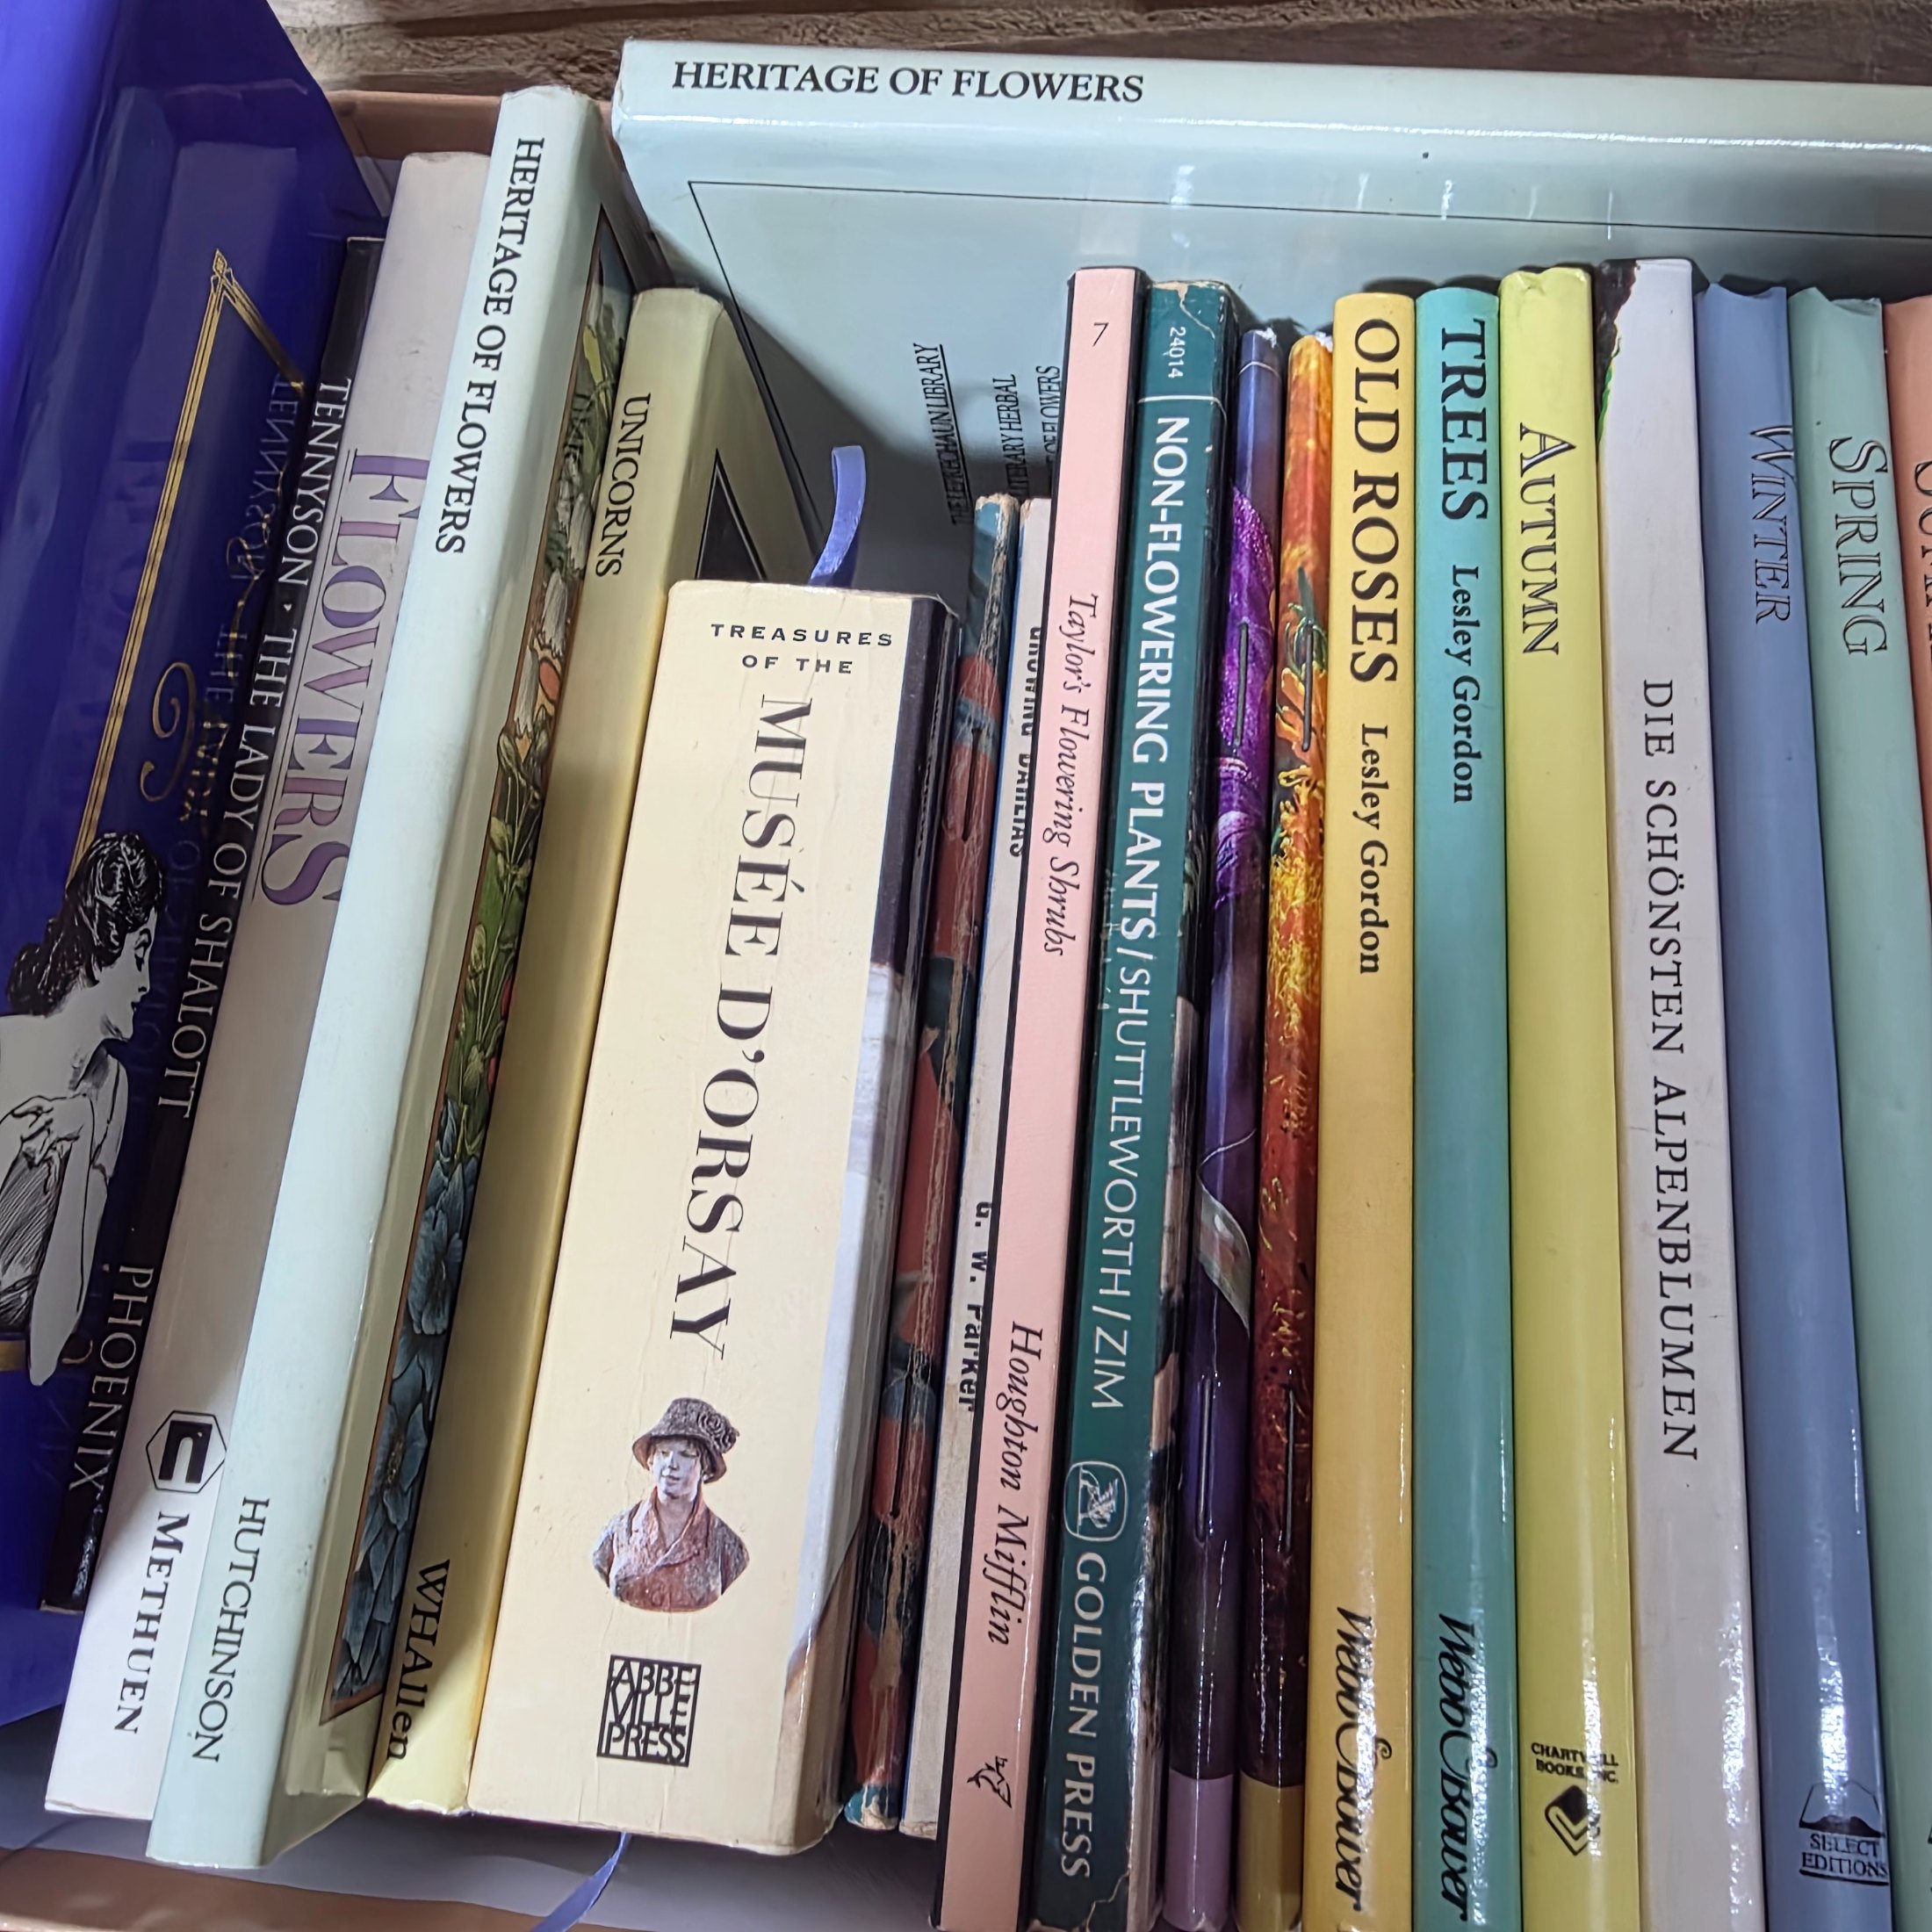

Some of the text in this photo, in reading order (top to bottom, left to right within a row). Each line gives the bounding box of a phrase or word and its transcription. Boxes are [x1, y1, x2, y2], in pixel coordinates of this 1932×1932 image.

[672, 61, 1143, 103] HERITAGE OF FLOWERS
[436, 138, 544, 553] HERITAGE OF FLOWERS
[913, 342, 950, 409] LIBRARY
[992, 373, 1023, 432] HERBAL
[1092, 322, 1109, 347] 7
[1168, 326, 1186, 378] 24014
[279, 378, 352, 587] TENNYSON
[595, 393, 652, 578] UNICORNS
[1440, 319, 1489, 804] TREES Lesley Gordon
[1518, 422, 1576, 657] AUTUMN
[1749, 425, 1797, 624] WINTER
[1829, 436, 1888, 655] SPRING
[249, 629, 298, 708] THE
[262, 449, 429, 905] FLOWERS
[710, 624, 892, 647] TREASURES
[741, 654, 853, 674] OF THE
[1133, 417, 1190, 762] NON-FLOWERING
[1350, 318, 1401, 975] OLD ROSES Lesley Gordon
[206, 840, 248, 903] OF
[223, 722, 277, 833] LADY
[1042, 594, 1099, 956] Taylor's Flowering Shrubs
[157, 912, 235, 1119] SHALOTT
[669, 694, 813, 1360] MUSÉE D'ORSAY
[1643, 680, 1698, 1460] DIE SCHÖNSTEN ALPENBLUMEN
[68, 1265, 155, 1491] PHOENIX
[983, 1320, 1043, 1646] Houghton Mifflin
[113, 1510, 191, 1734] METHUEN
[191, 1496, 270, 1763] HUTCHINSON
[1061, 1552, 1107, 1878] GOLDEN PRESS
[604, 1722, 686, 1763] PRESS
[1809, 1833, 1878, 1857] SELECT
